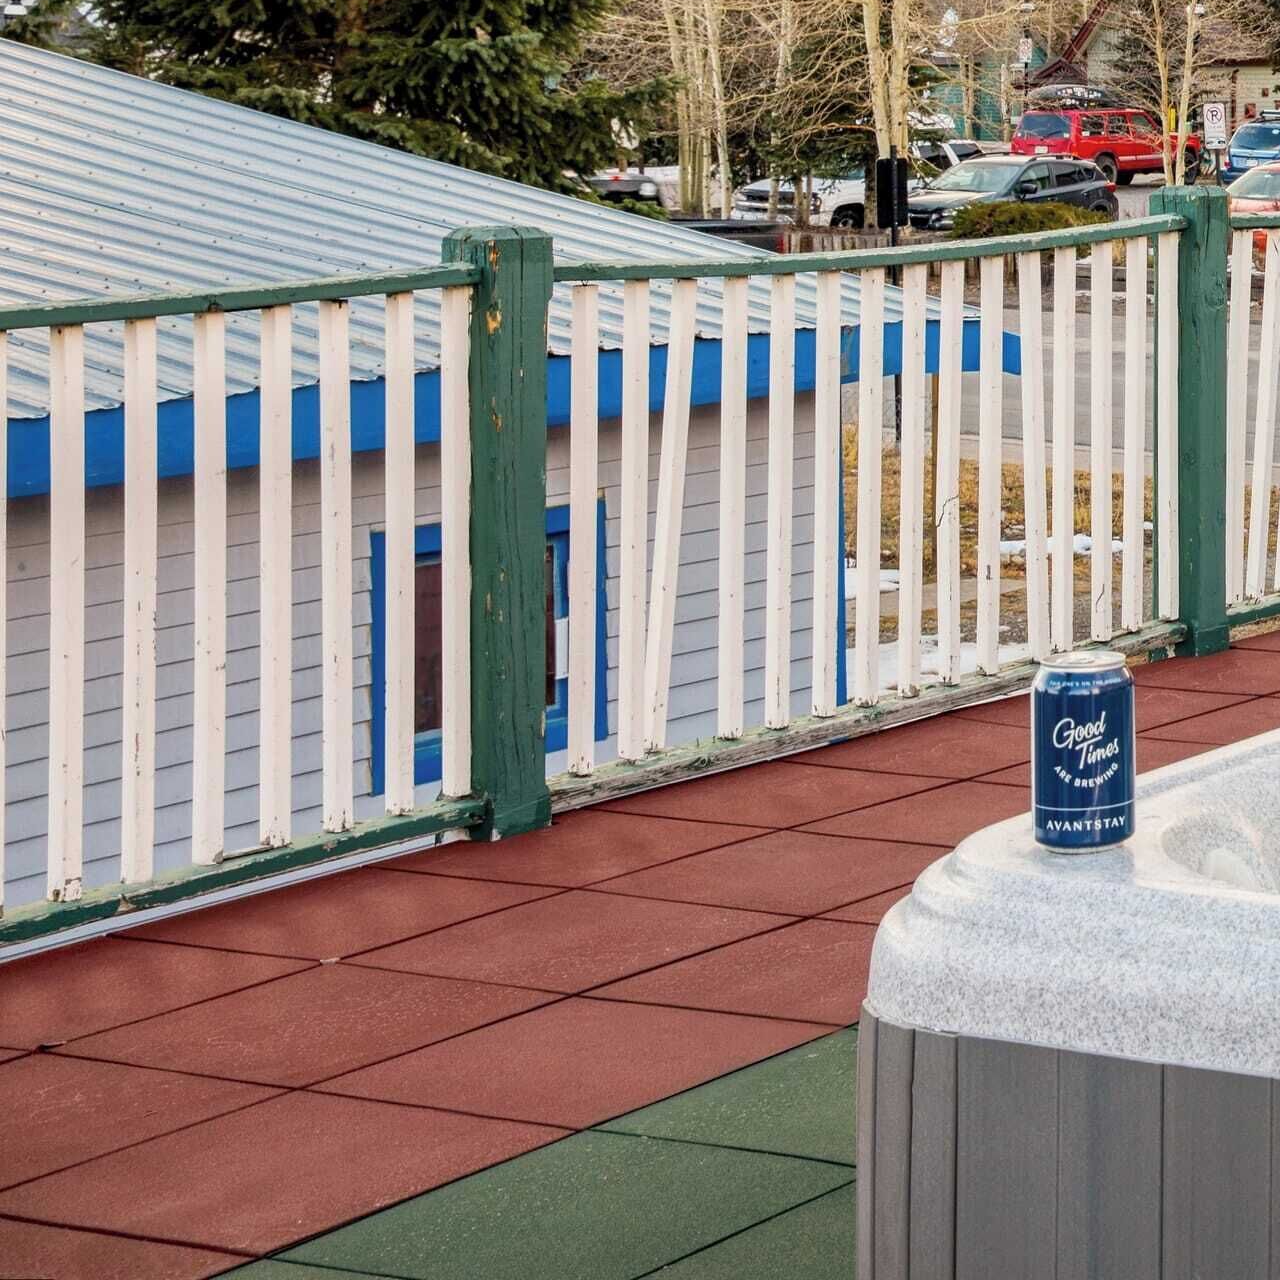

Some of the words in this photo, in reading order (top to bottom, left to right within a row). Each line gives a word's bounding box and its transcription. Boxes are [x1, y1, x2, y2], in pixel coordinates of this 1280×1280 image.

[1053, 711, 1106, 750] Good
[1075, 736, 1119, 770] Times
[1054, 765, 1072, 784] ARE
[1074, 762, 1118, 788] BREWING
[1046, 815, 1125, 832] AVANTSTAY
